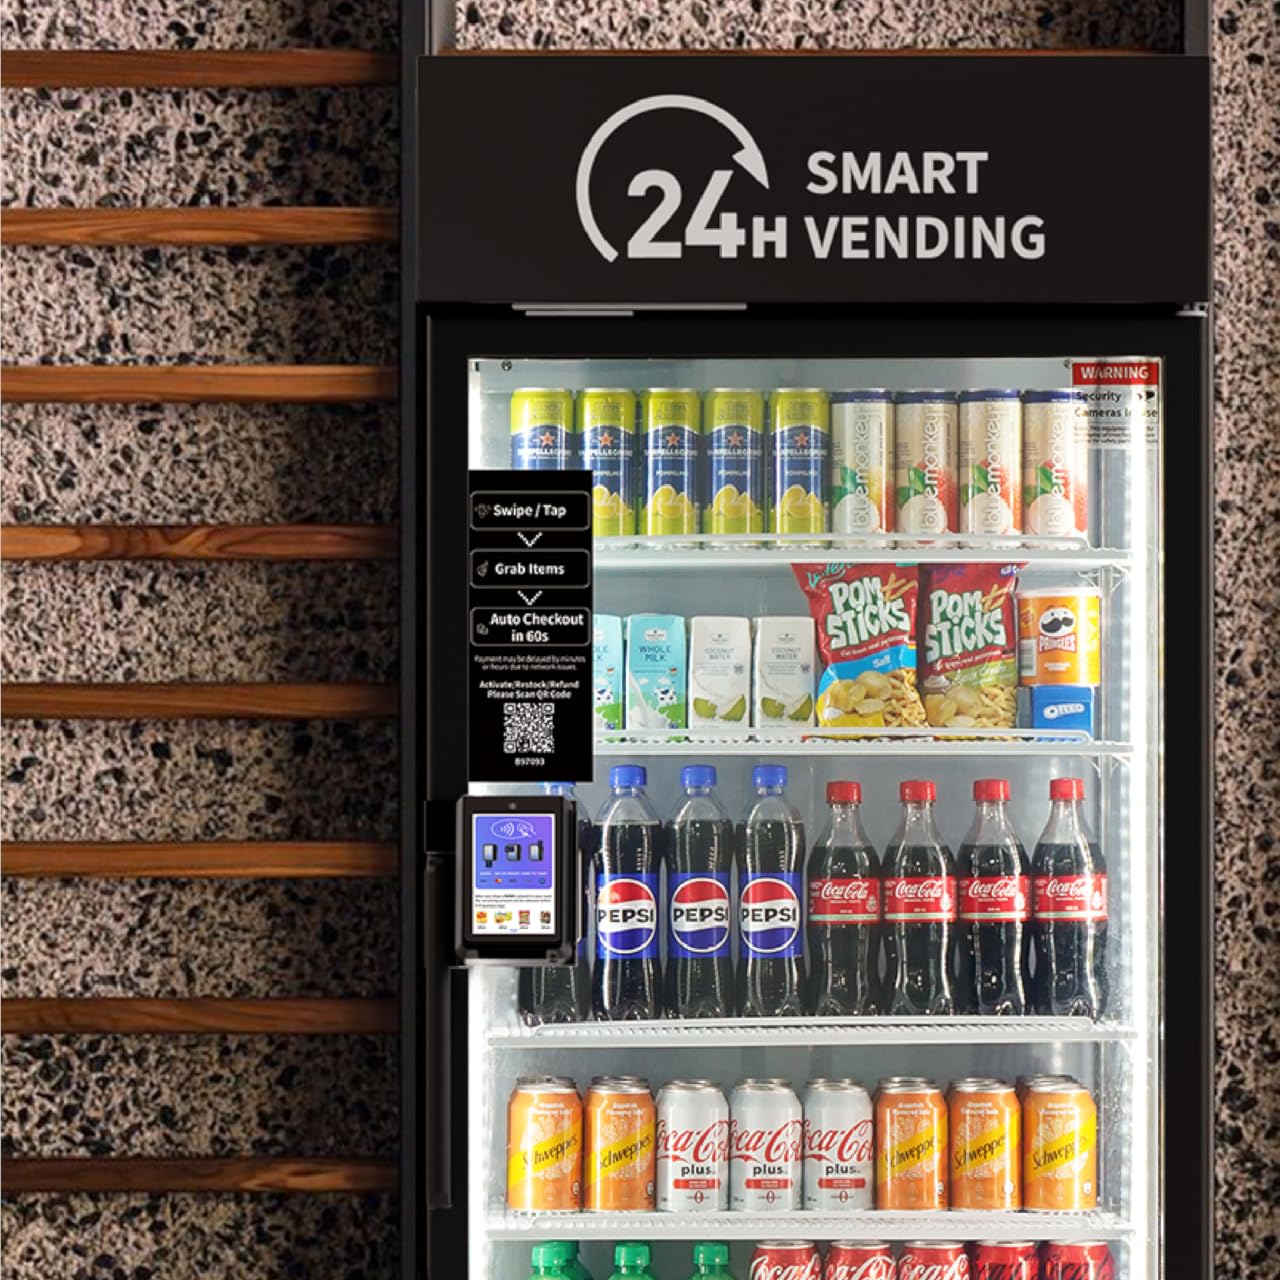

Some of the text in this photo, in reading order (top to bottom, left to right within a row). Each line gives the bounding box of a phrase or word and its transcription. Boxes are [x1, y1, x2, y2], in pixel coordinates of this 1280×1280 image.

[806, 150, 989, 195] SMART
[626, 169, 787, 260] 24H
[803, 215, 1046, 261] VENDING
[1080, 366, 1150, 380] WARNING
[1076, 391, 1122, 403] Security
[493, 502, 567, 519] Swipe / Tap
[494, 562, 566, 576] Grab Items
[828, 576, 885, 616] POM
[929, 589, 985, 625] POM
[489, 612, 584, 626] Auto Checkout
[826, 598, 912, 650] STICKS
[511, 629, 550, 643] in 60s
[925, 608, 1008, 664] STICKS
[487, 689, 515, 700] Please
[516, 689, 536, 700] Scan
[550, 689, 572, 700] Code
[821, 881, 870, 900] Coca-Cola
[895, 880, 944, 899] Coca-Cola
[598, 908, 654, 923] PEPSI
[673, 907, 729, 923] PEPSI
[741, 907, 797, 923] PEPSI
[522, 1134, 577, 1166] Shweppes
[600, 1133, 652, 1169] chweppes
[681, 1164, 712, 1177] plus
[752, 1164, 784, 1177] plus
[825, 1164, 857, 1177] plus
